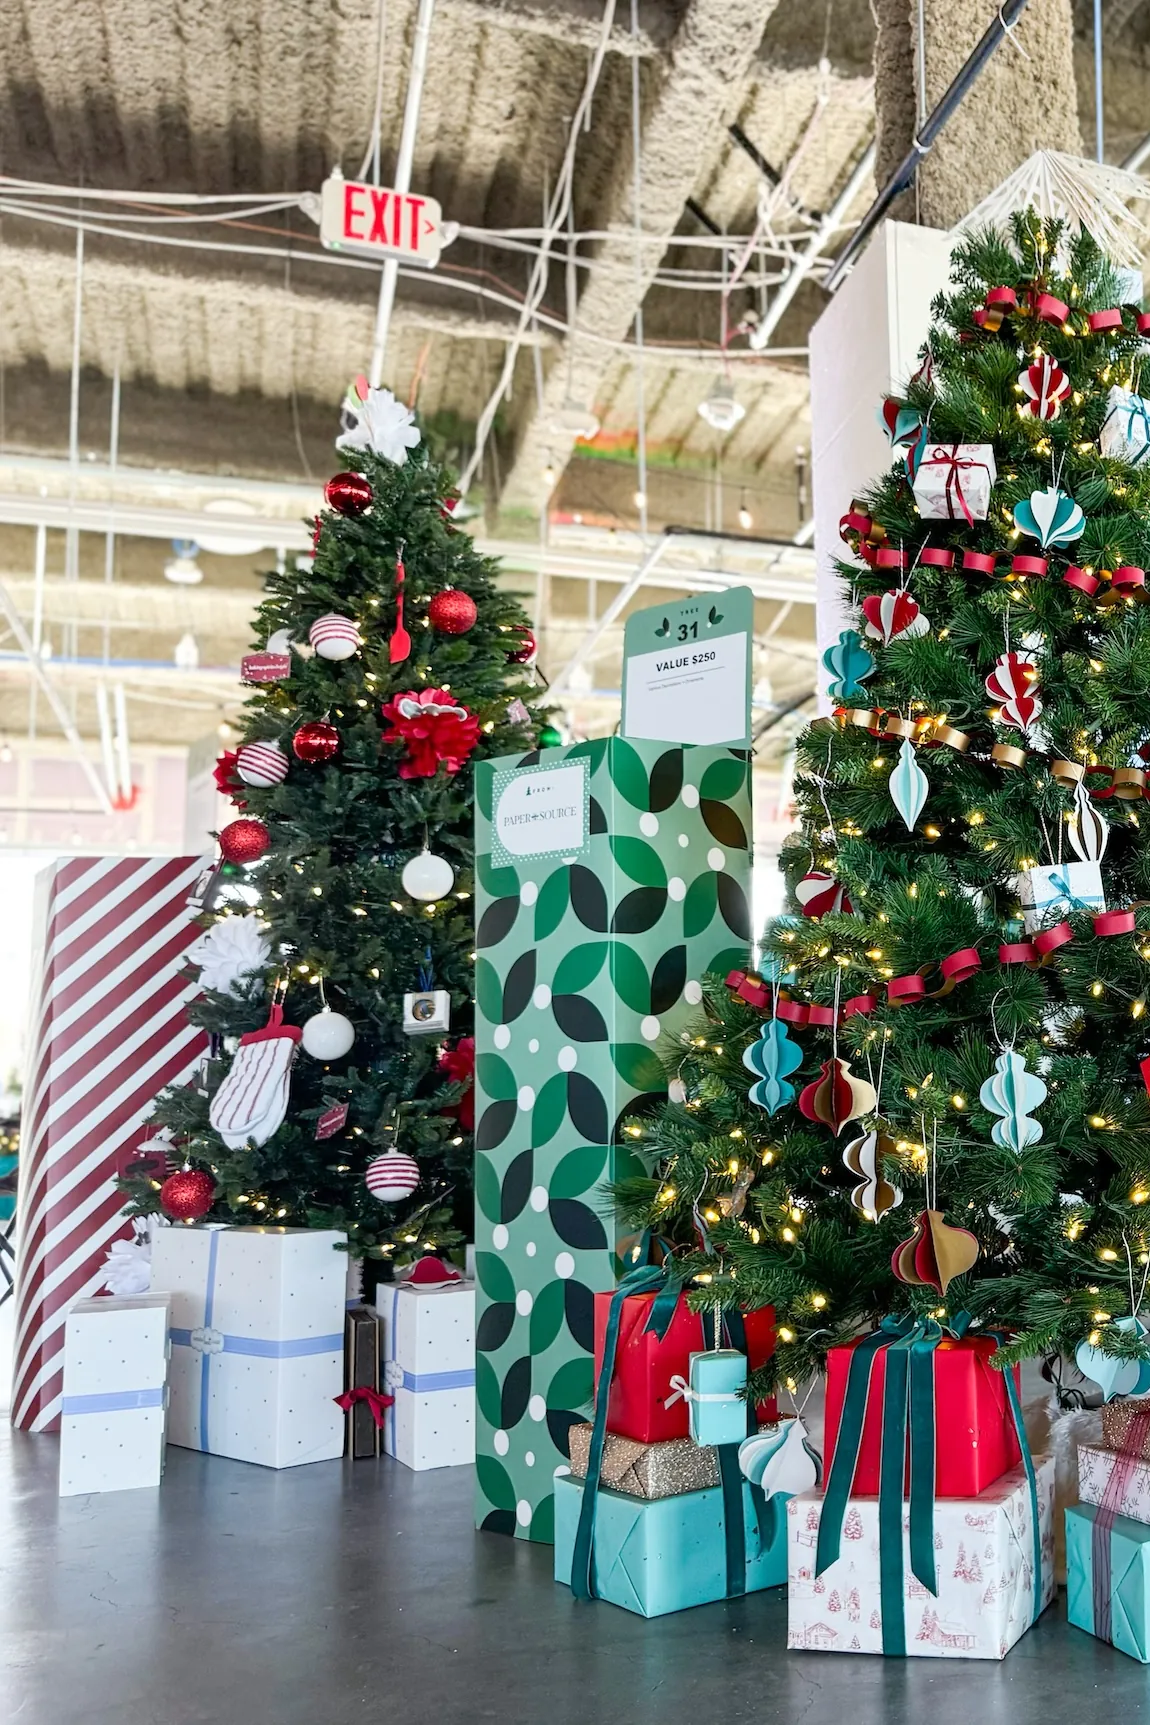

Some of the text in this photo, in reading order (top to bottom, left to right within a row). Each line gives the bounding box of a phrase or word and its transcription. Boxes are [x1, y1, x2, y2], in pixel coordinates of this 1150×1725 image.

[344, 185, 425, 251] EXIT
[680, 607, 699, 616] TREE
[677, 621, 698, 641] 31
[656, 651, 716, 672] VALUE $250
[504, 806, 577, 827] PAPER SOURCE
